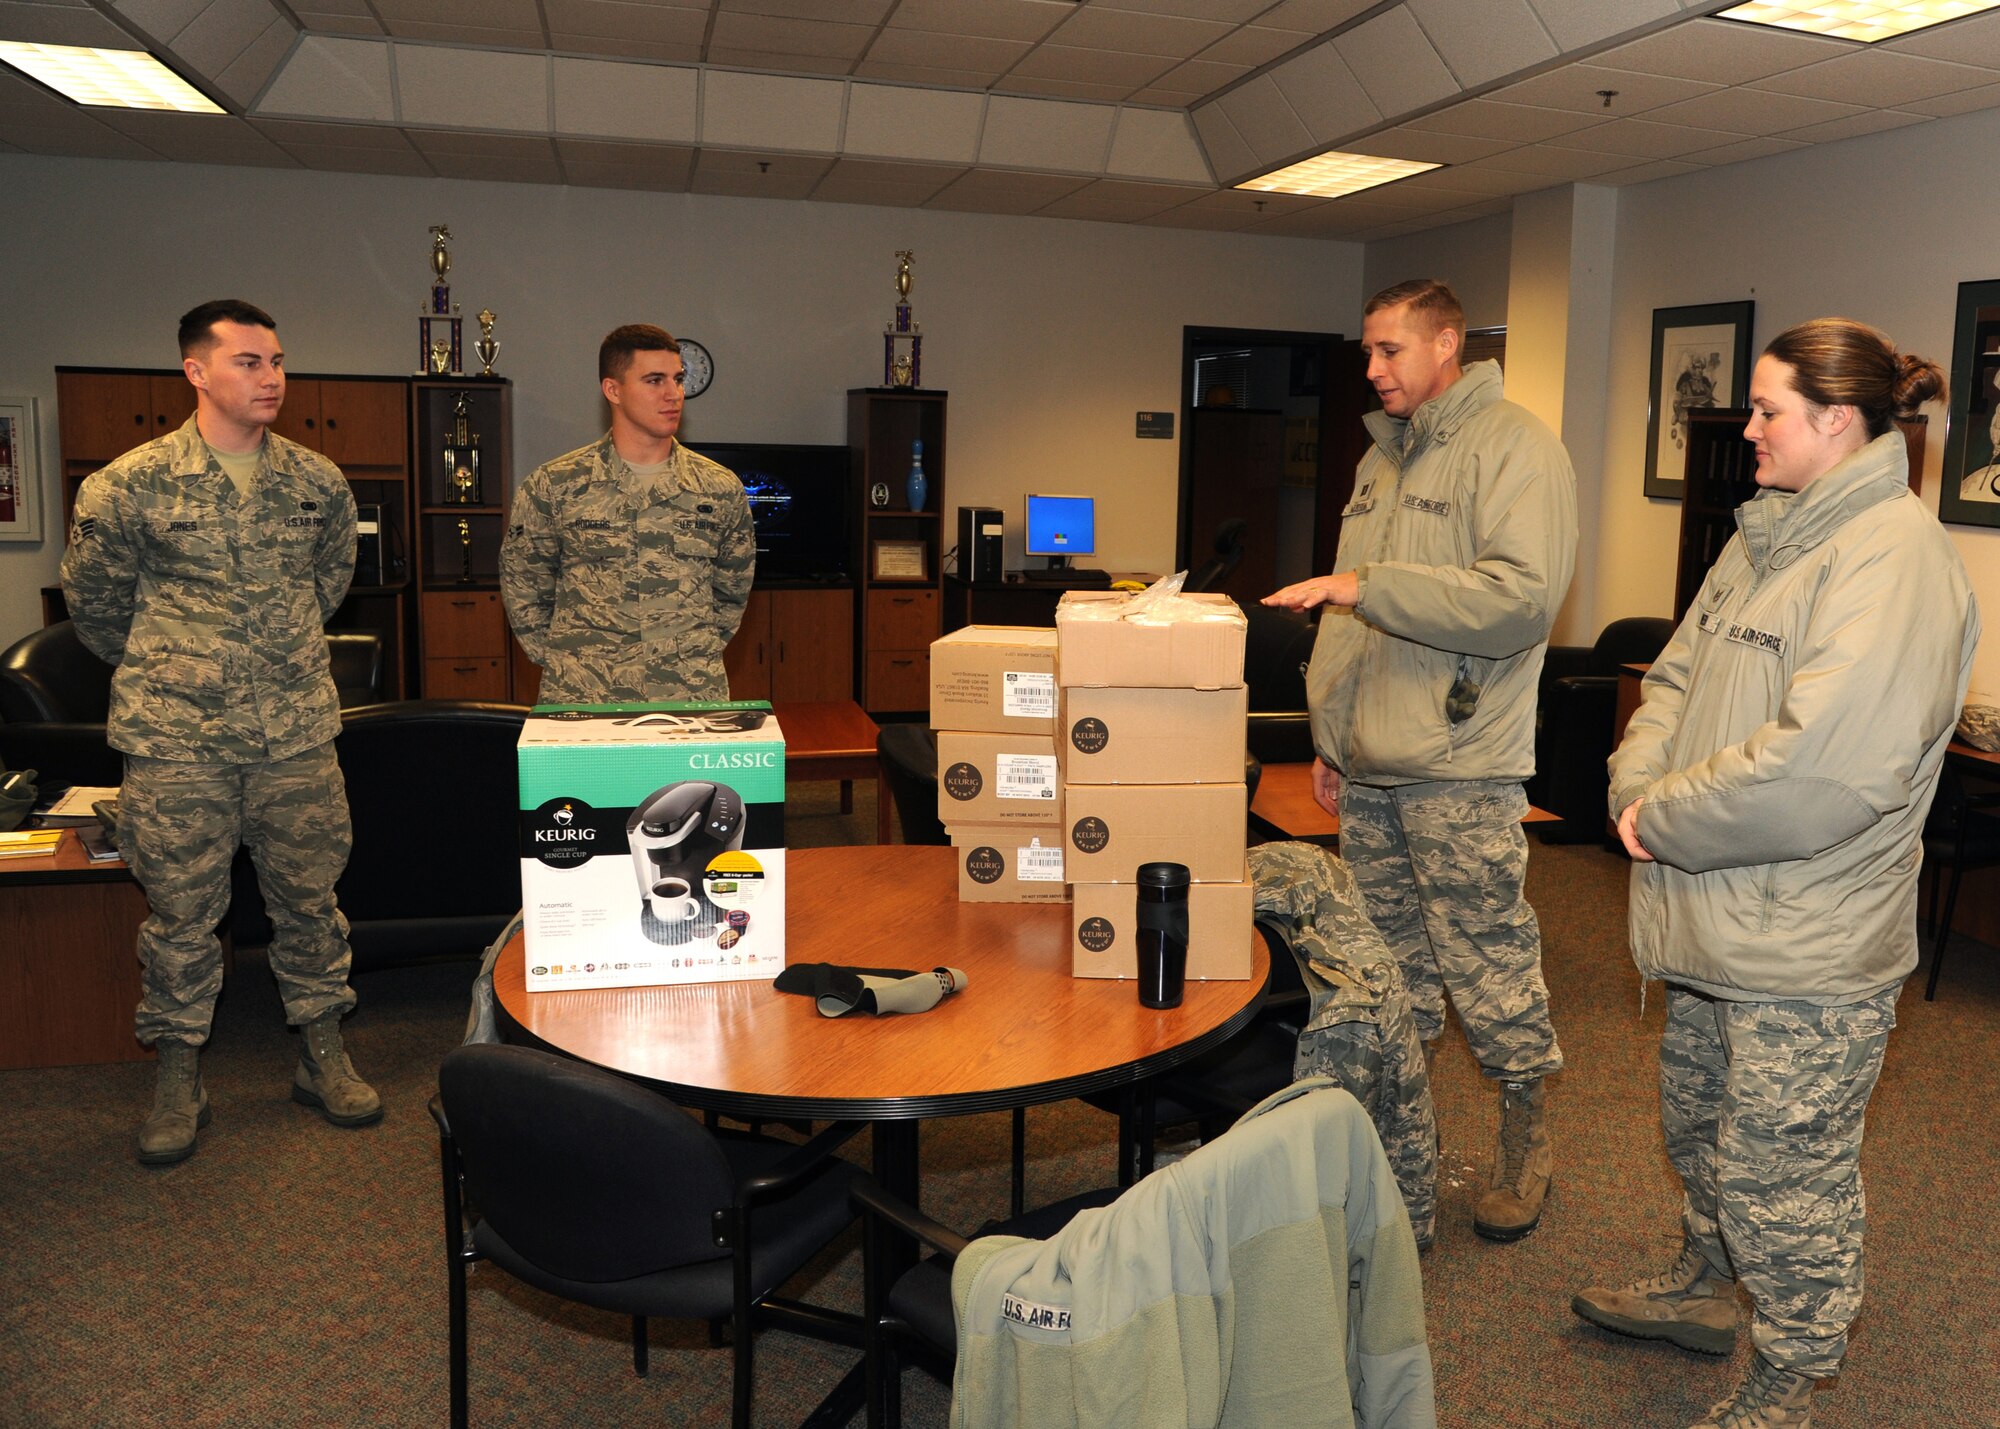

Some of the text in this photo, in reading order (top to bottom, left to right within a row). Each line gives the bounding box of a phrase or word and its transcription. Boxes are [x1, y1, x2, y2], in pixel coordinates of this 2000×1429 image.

[1139, 413, 1153, 422] 116
[167, 521, 198, 532] JONES
[1740, 627, 1756, 644] AIR
[1755, 631, 1782, 652] FORCE
[1075, 732, 1105, 740] KEURIG
[689, 752, 776, 770] CLASSIC
[947, 777, 979, 786] KEURIG
[535, 827, 597, 843] KEURIG
[1075, 831, 1106, 840] KEURIG
[544, 852, 571, 860] SINGLE
[969, 861, 1001, 870] KEURIG
[1004, 1298, 1025, 1323] U.S.
[1028, 1307, 1054, 1328] AIR
